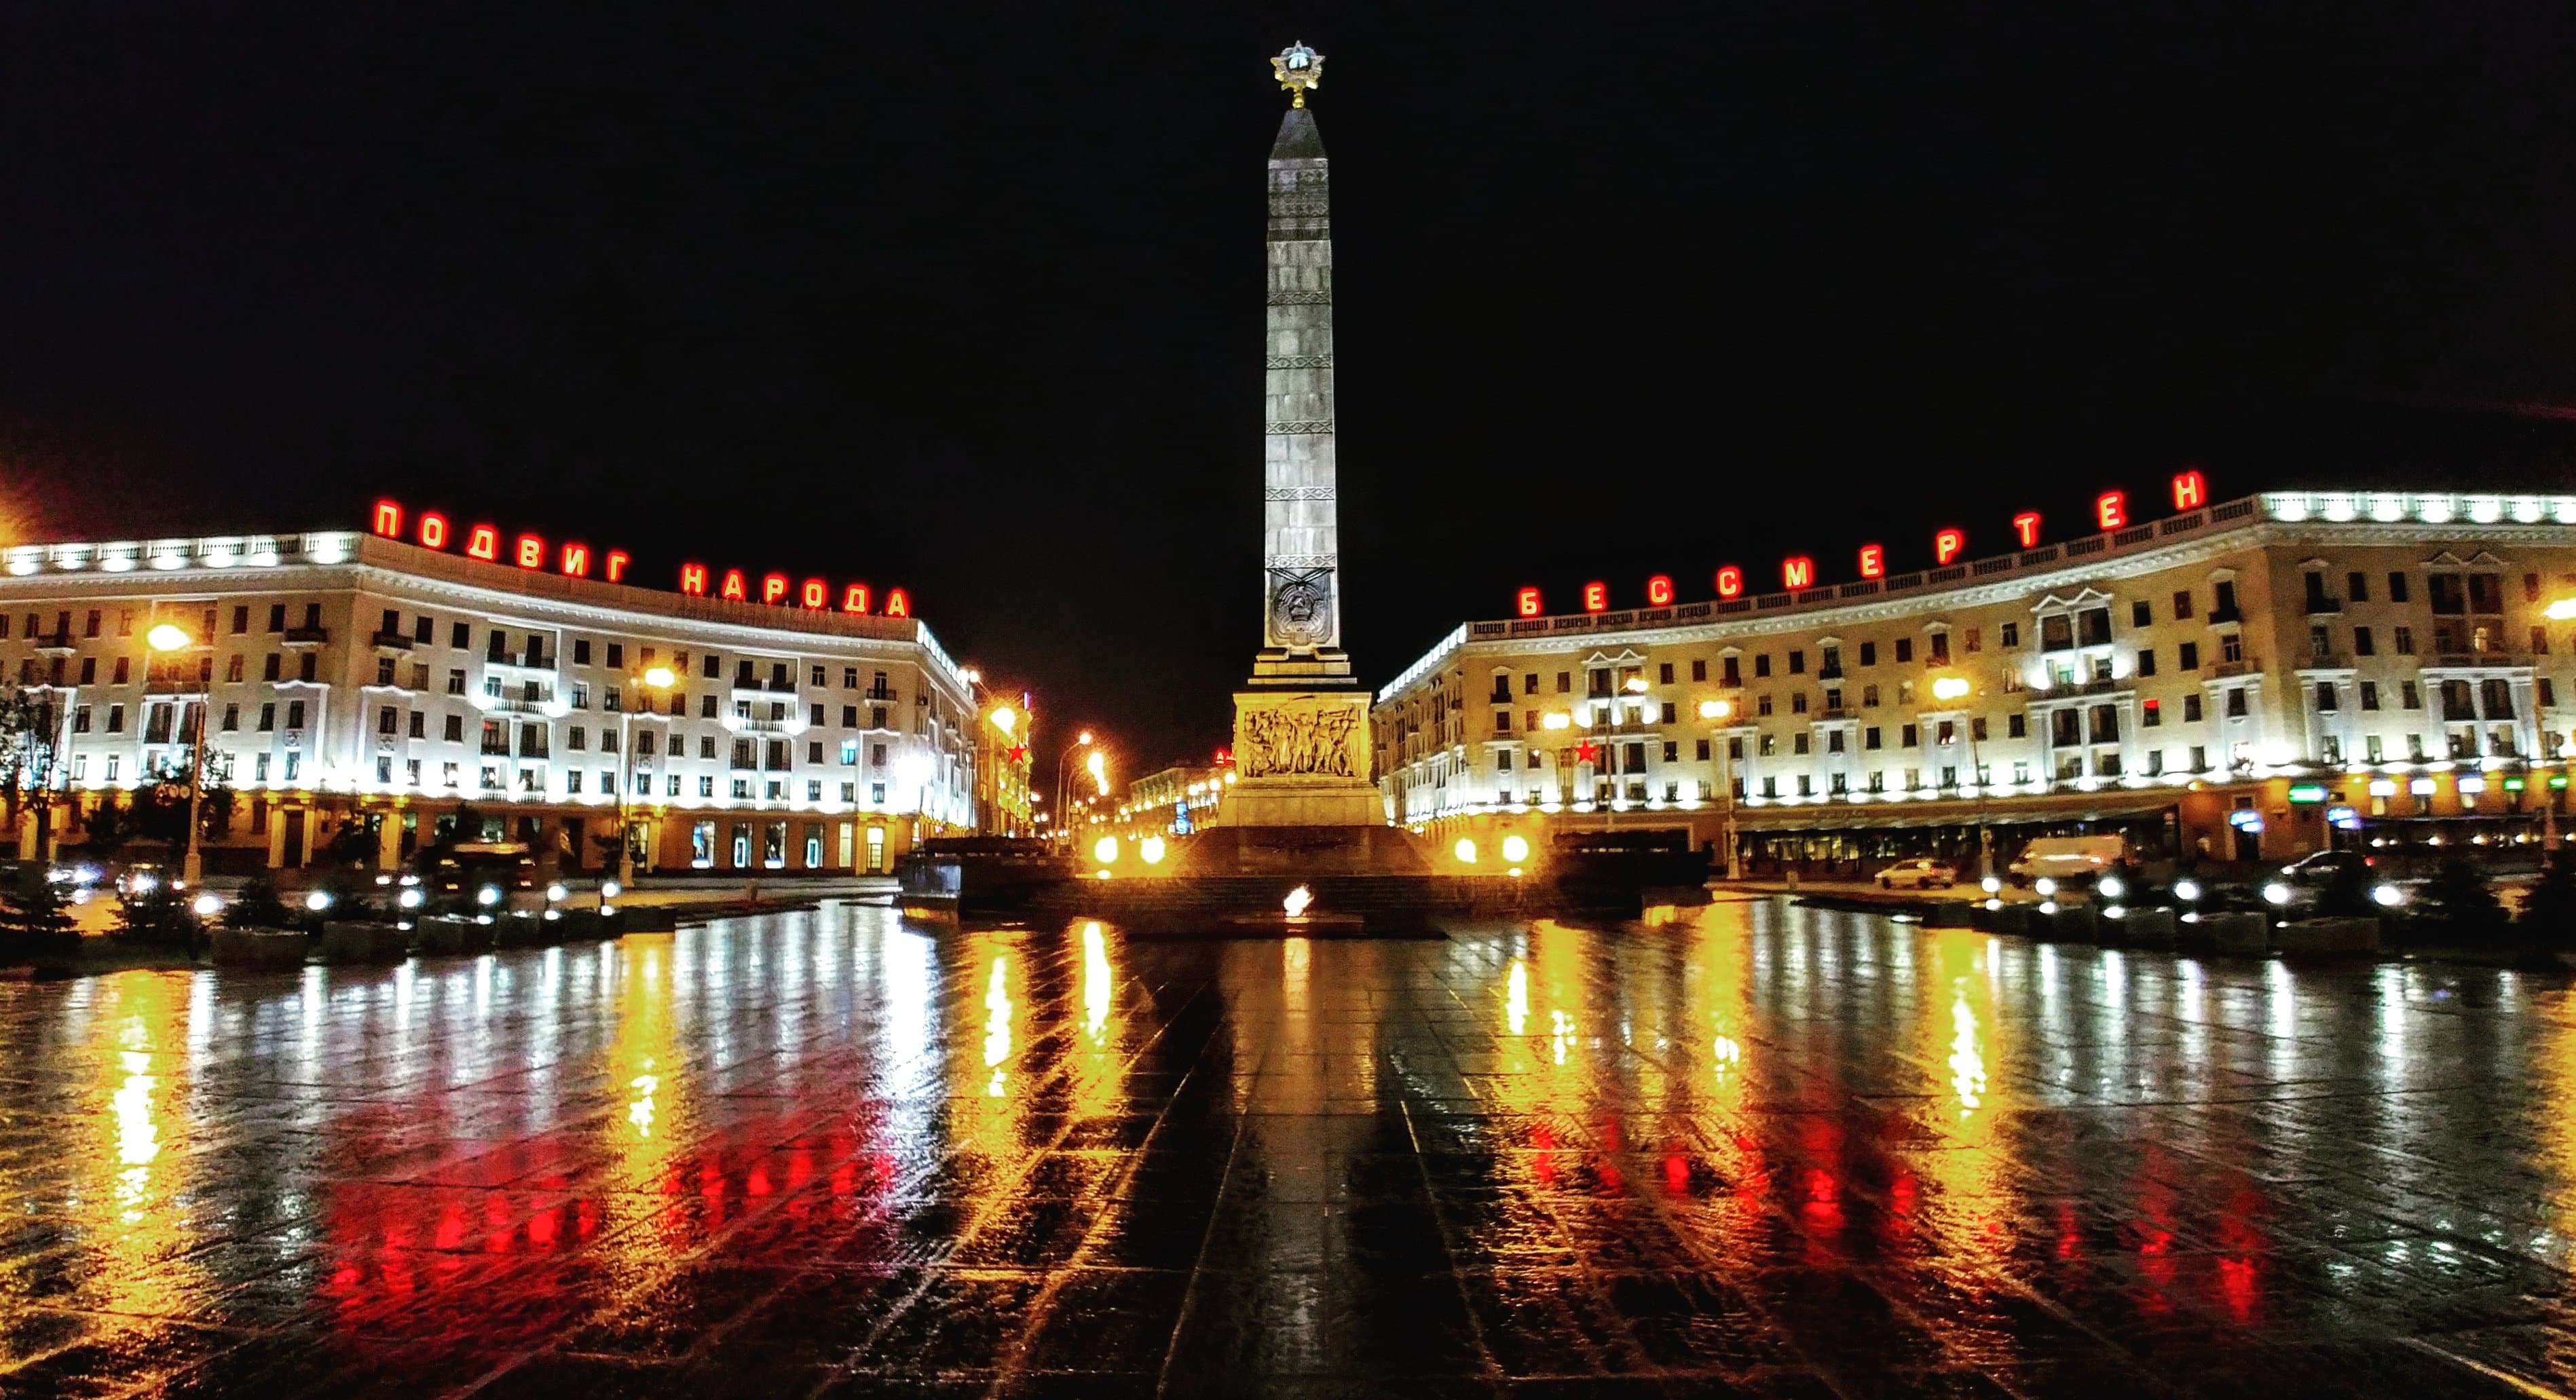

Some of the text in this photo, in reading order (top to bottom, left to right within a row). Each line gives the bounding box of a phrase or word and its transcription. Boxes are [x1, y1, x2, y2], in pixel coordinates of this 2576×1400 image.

[375, 502, 908, 617] ПОДВИГ НАРОДА
[1520, 474, 2201, 617] БЕССМЕРТЕН
